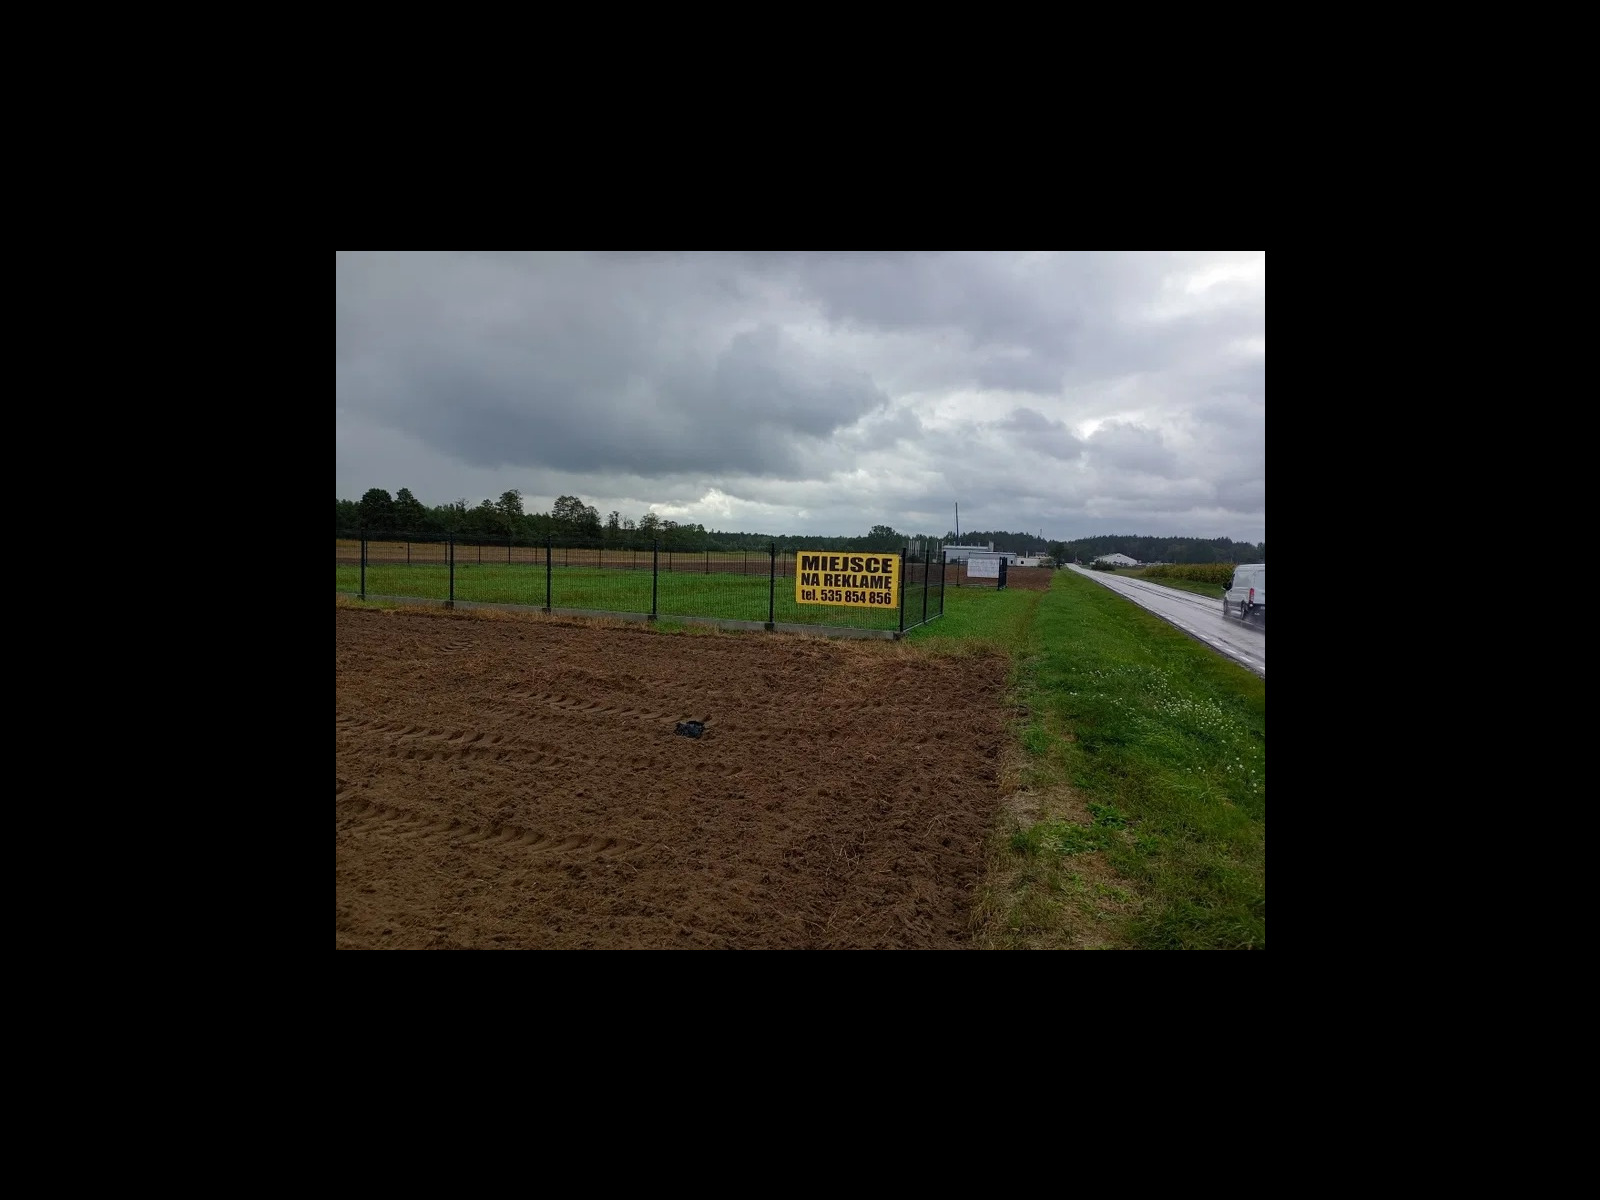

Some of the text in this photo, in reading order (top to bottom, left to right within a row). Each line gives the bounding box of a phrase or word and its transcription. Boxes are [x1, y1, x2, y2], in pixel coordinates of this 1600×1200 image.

[801, 555, 893, 573] MIEJSCE
[801, 573, 820, 586] NA
[801, 589, 891, 604] tel. 535 854 856
